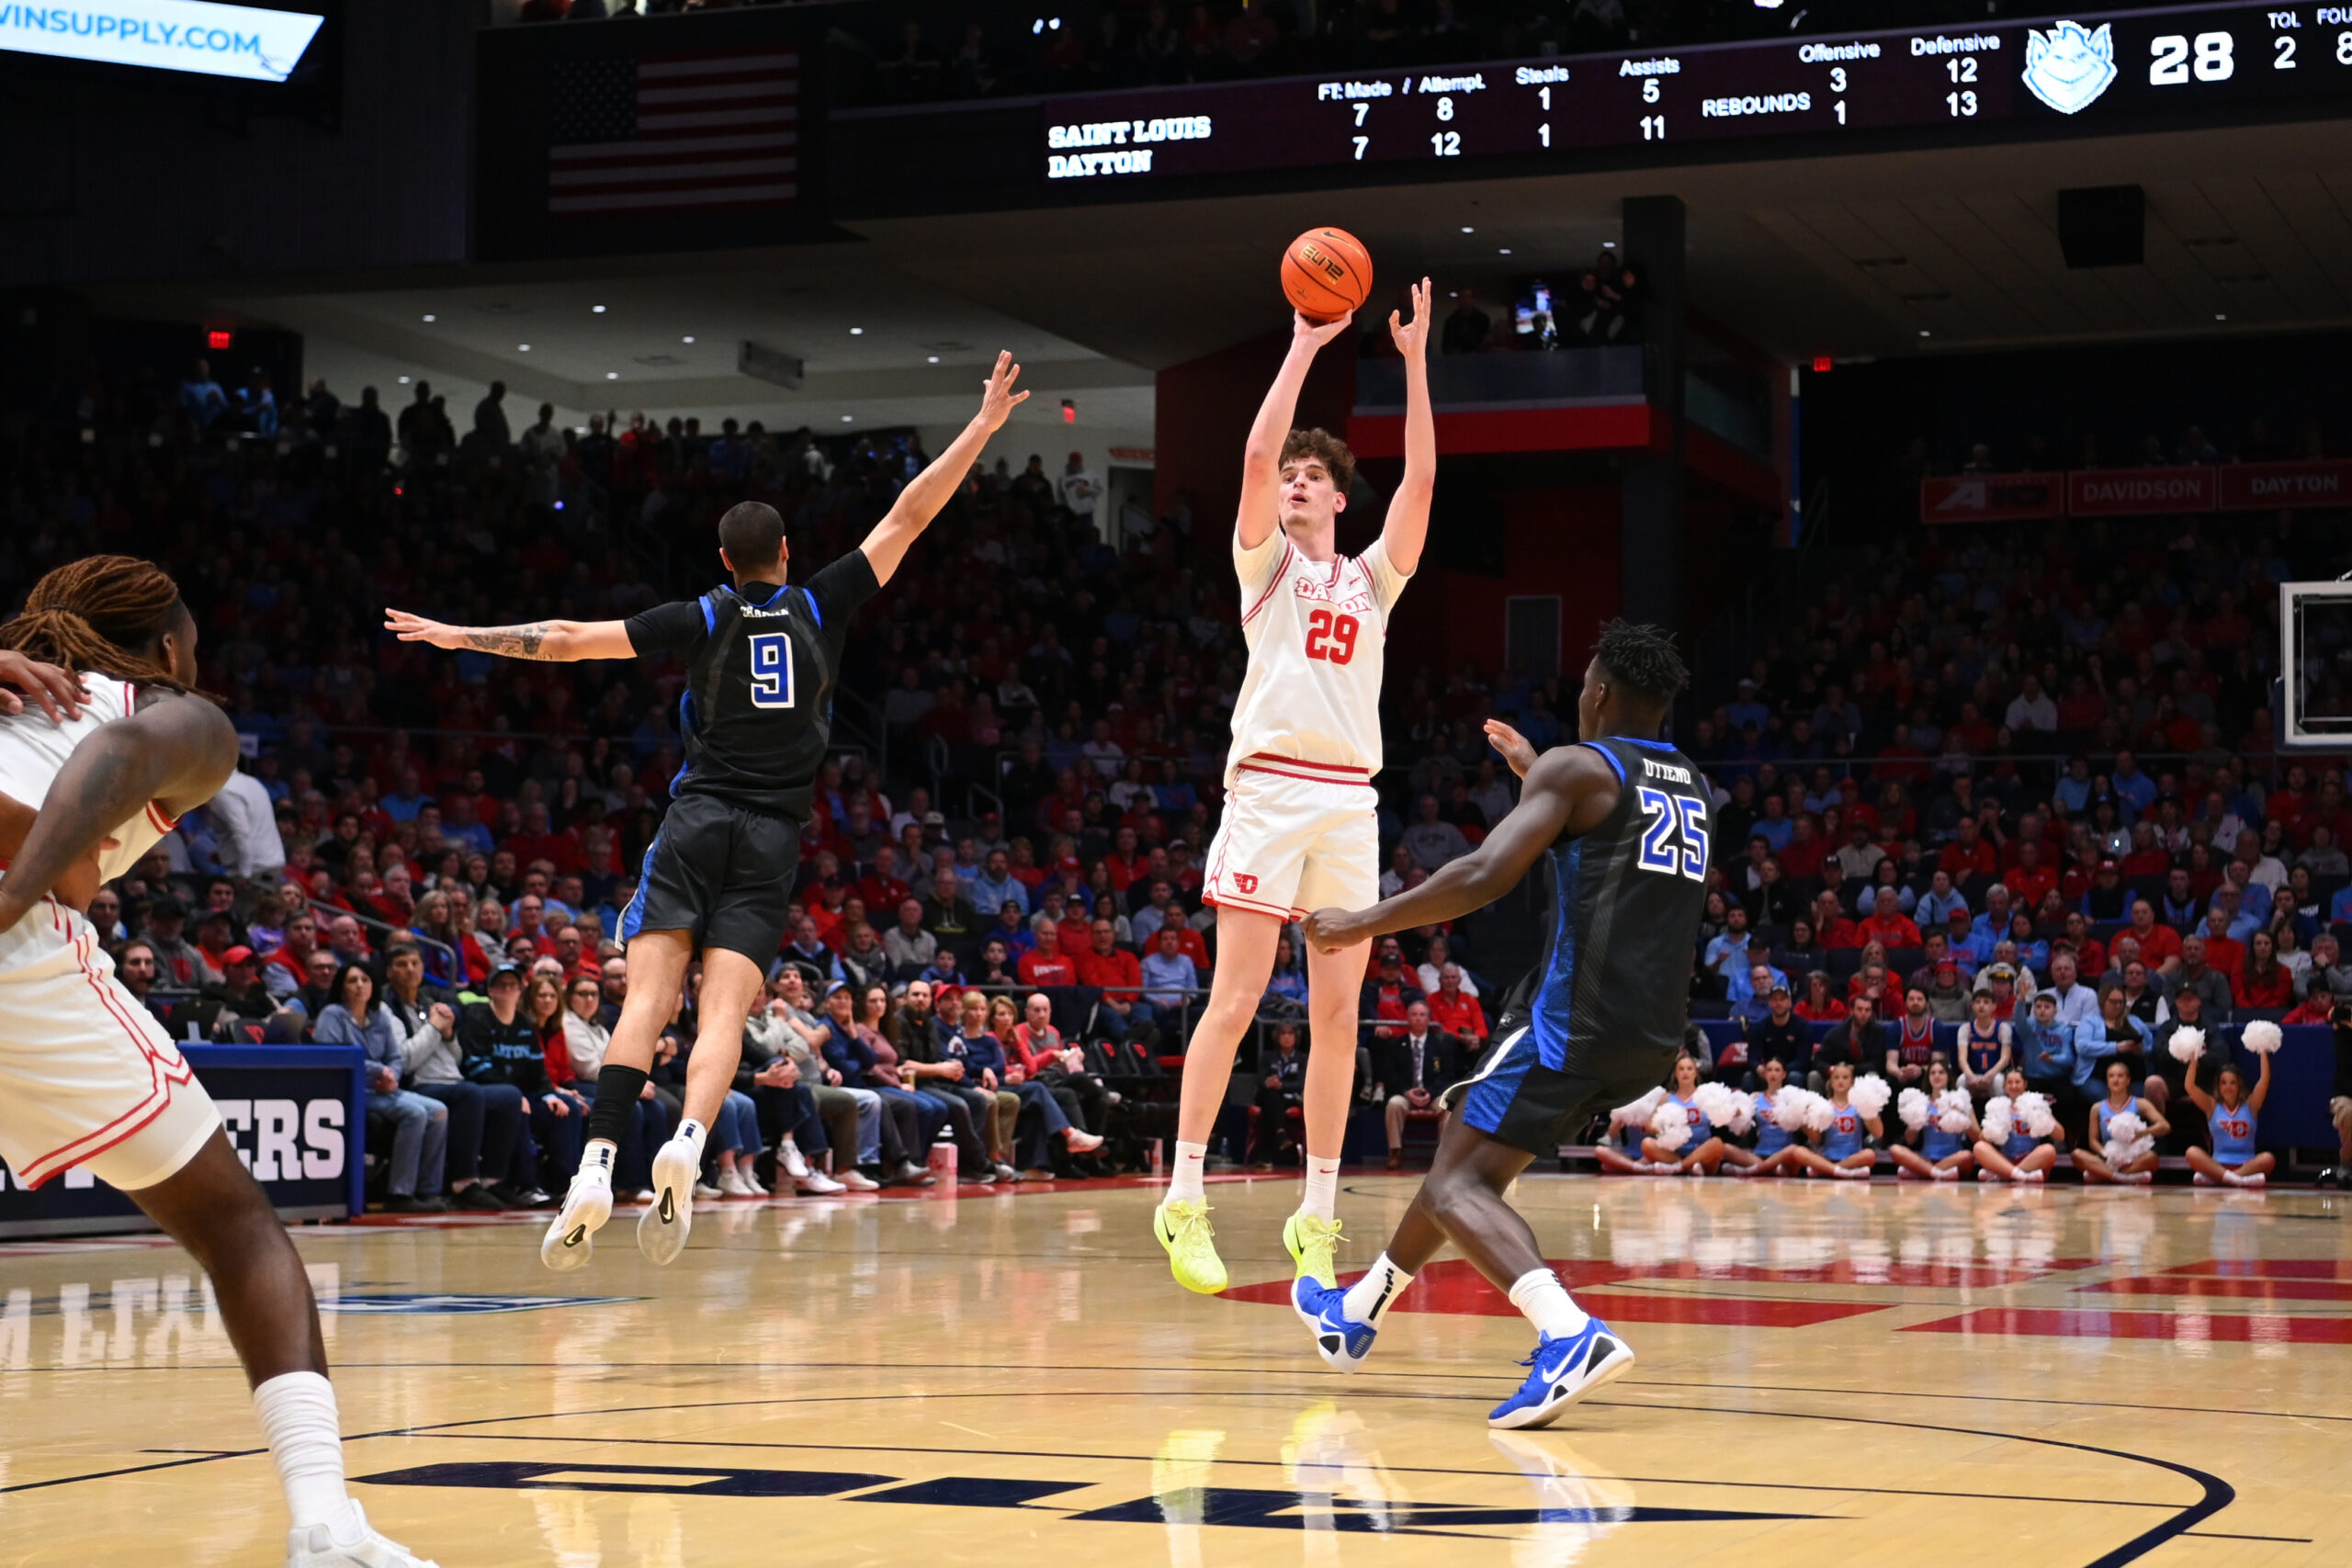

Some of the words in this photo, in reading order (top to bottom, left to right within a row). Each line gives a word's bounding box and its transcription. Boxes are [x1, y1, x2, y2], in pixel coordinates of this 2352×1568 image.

[2267, 10, 2302, 29] TOL
[1798, 40, 1882, 63] Offensive
[1910, 33, 2002, 57] Defensive
[2149, 30, 2234, 86] 28
[2273, 35, 2297, 70] 2
[2335, 30, 2352, 65] 8
[1515, 64, 1570, 85] Steals
[1618, 56, 1681, 78] Assists
[1829, 66, 1848, 93] 3
[1946, 56, 1978, 84] 12
[1344, 80, 1393, 99] Made
[1538, 85, 1551, 111] 1
[1642, 77, 1660, 104] 5
[1352, 102, 1370, 128] 7
[1436, 96, 1454, 121] 8
[1702, 91, 1812, 118] REBOUNDS
[1833, 99, 1846, 126] 1
[1946, 90, 1978, 118] 13
[1047, 120, 1131, 149] SAINT
[1133, 115, 1212, 143] LOUIS
[1537, 122, 1550, 148] 1
[1639, 114, 1665, 141] 11
[1351, 135, 1370, 161] 7
[1430, 130, 1461, 157] 12
[1047, 149, 1154, 179] DAYTON
[2083, 479, 2202, 502] DAVIDSON
[2251, 473, 2339, 496] DAYTON
[1295, 576, 1373, 615] DAON
[1306, 608, 1360, 666] 29
[747, 632, 796, 709] 9
[1635, 785, 1710, 883] 25
[213, 1098, 345, 1181] ERS
